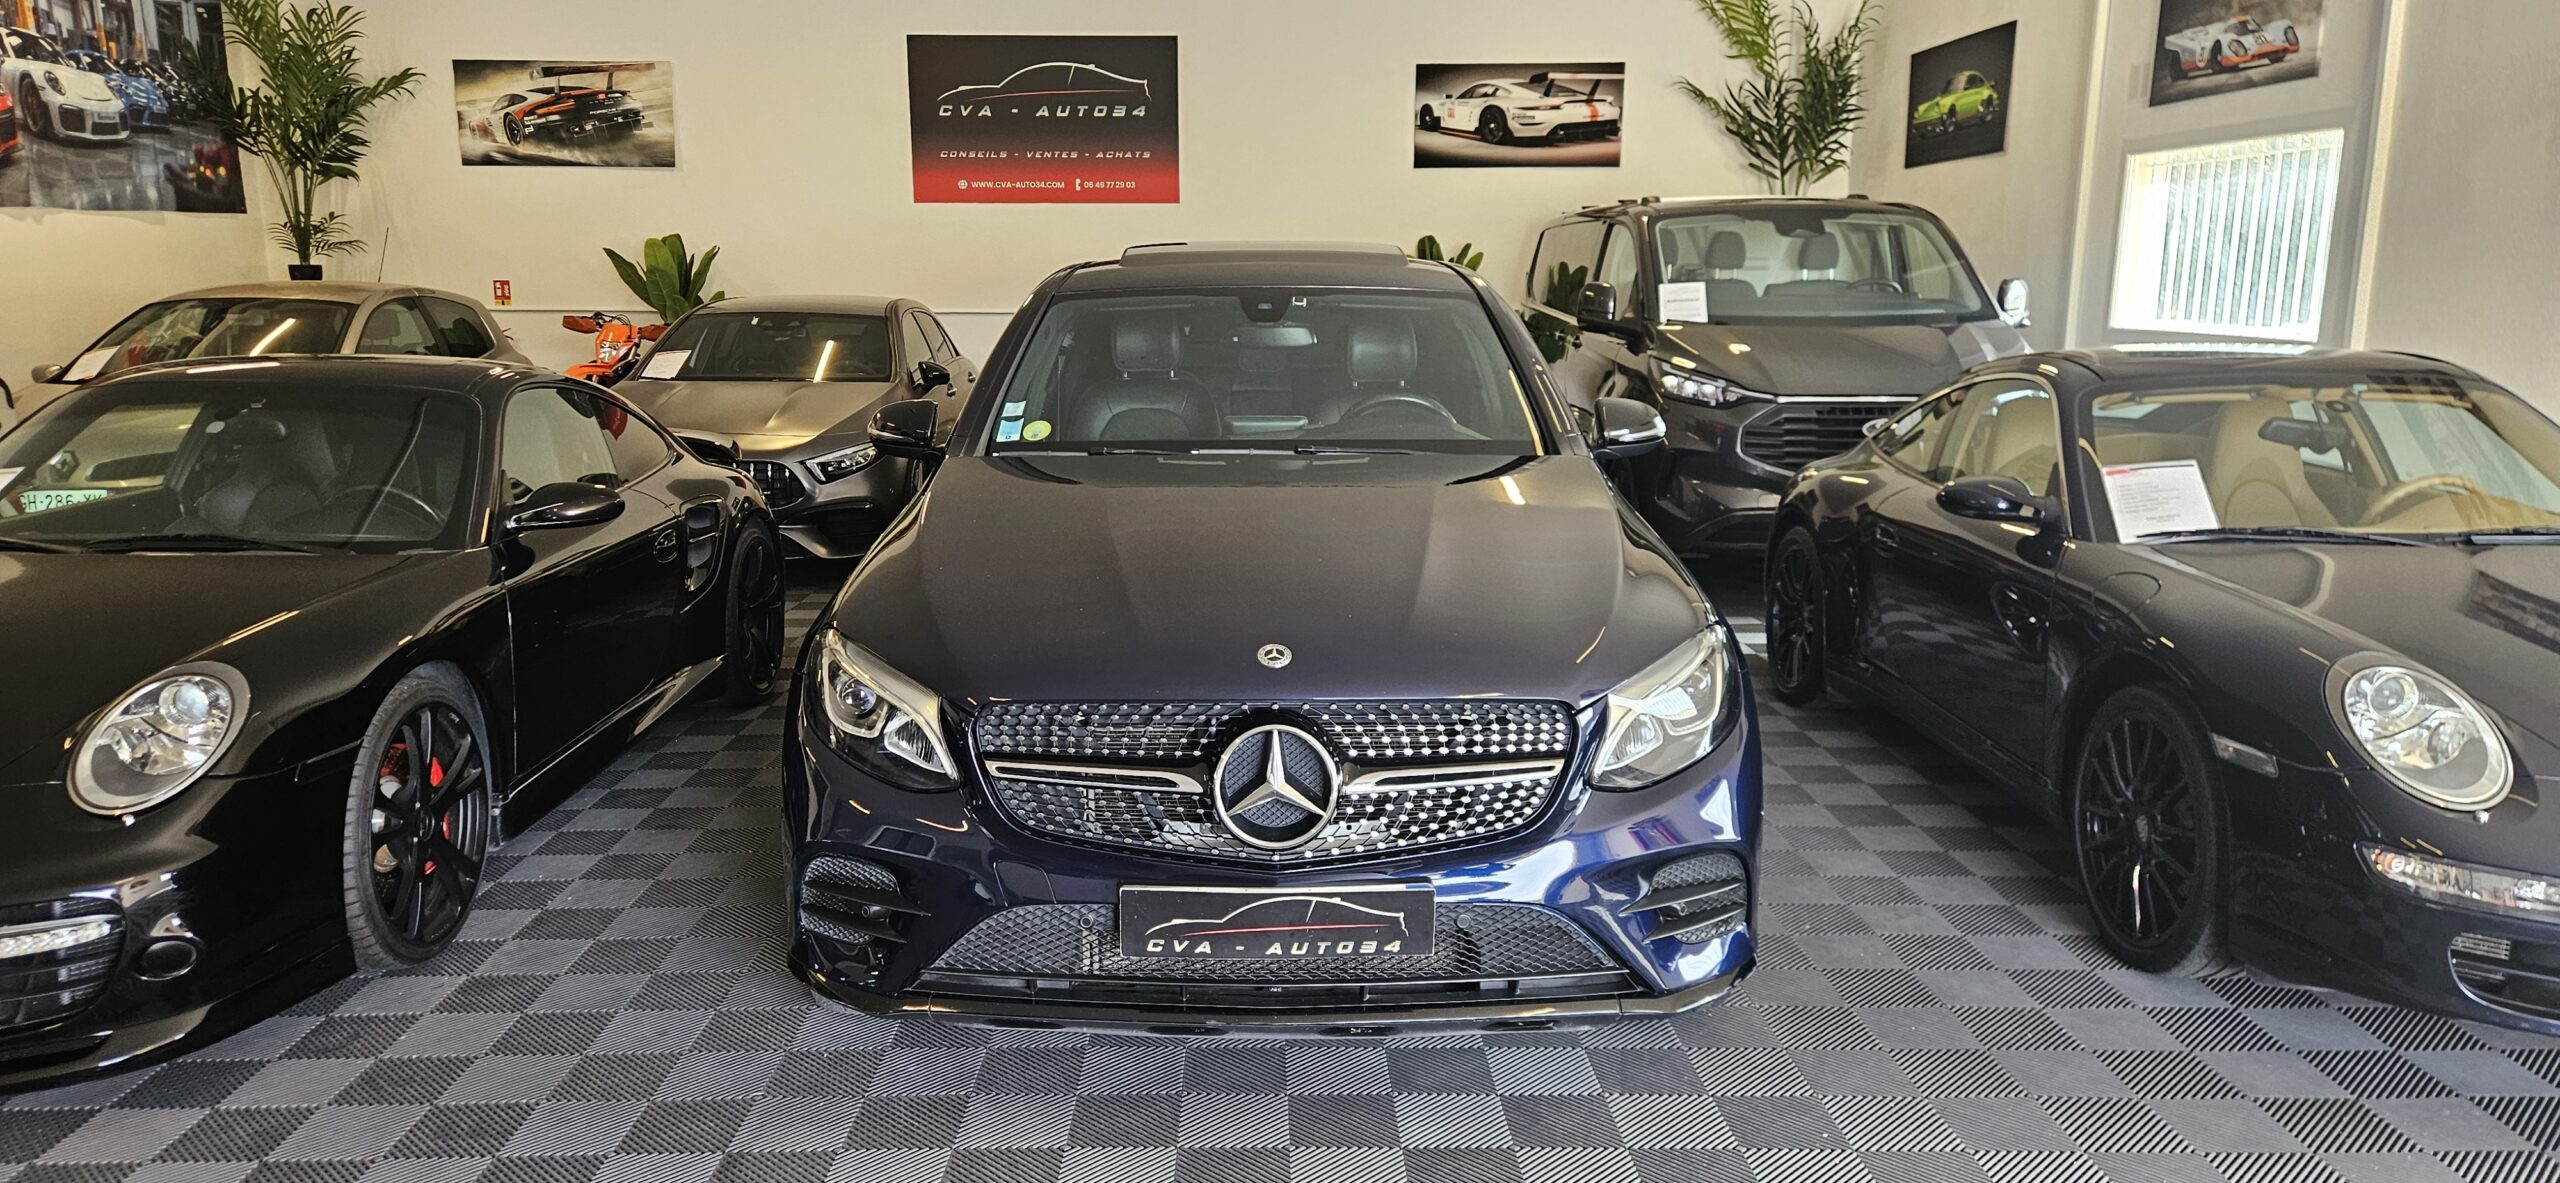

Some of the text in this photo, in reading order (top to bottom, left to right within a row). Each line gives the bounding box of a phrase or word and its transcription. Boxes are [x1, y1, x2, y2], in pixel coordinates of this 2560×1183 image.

[939, 104, 992, 117] CVA
[1035, 105, 1147, 117] AUTO34
[940, 150, 1008, 158] CONSEILS
[1026, 151, 1078, 159] VENTES
[1096, 151, 1151, 159] ACHATS
[971, 181, 1065, 189] WWW.CVA-AUTO34.COM
[1106, 181, 1115, 189] 77
[1126, 181, 1136, 189] 03
[1146, 939, 1212, 955] CVA
[1265, 939, 1402, 956] AUTO34
